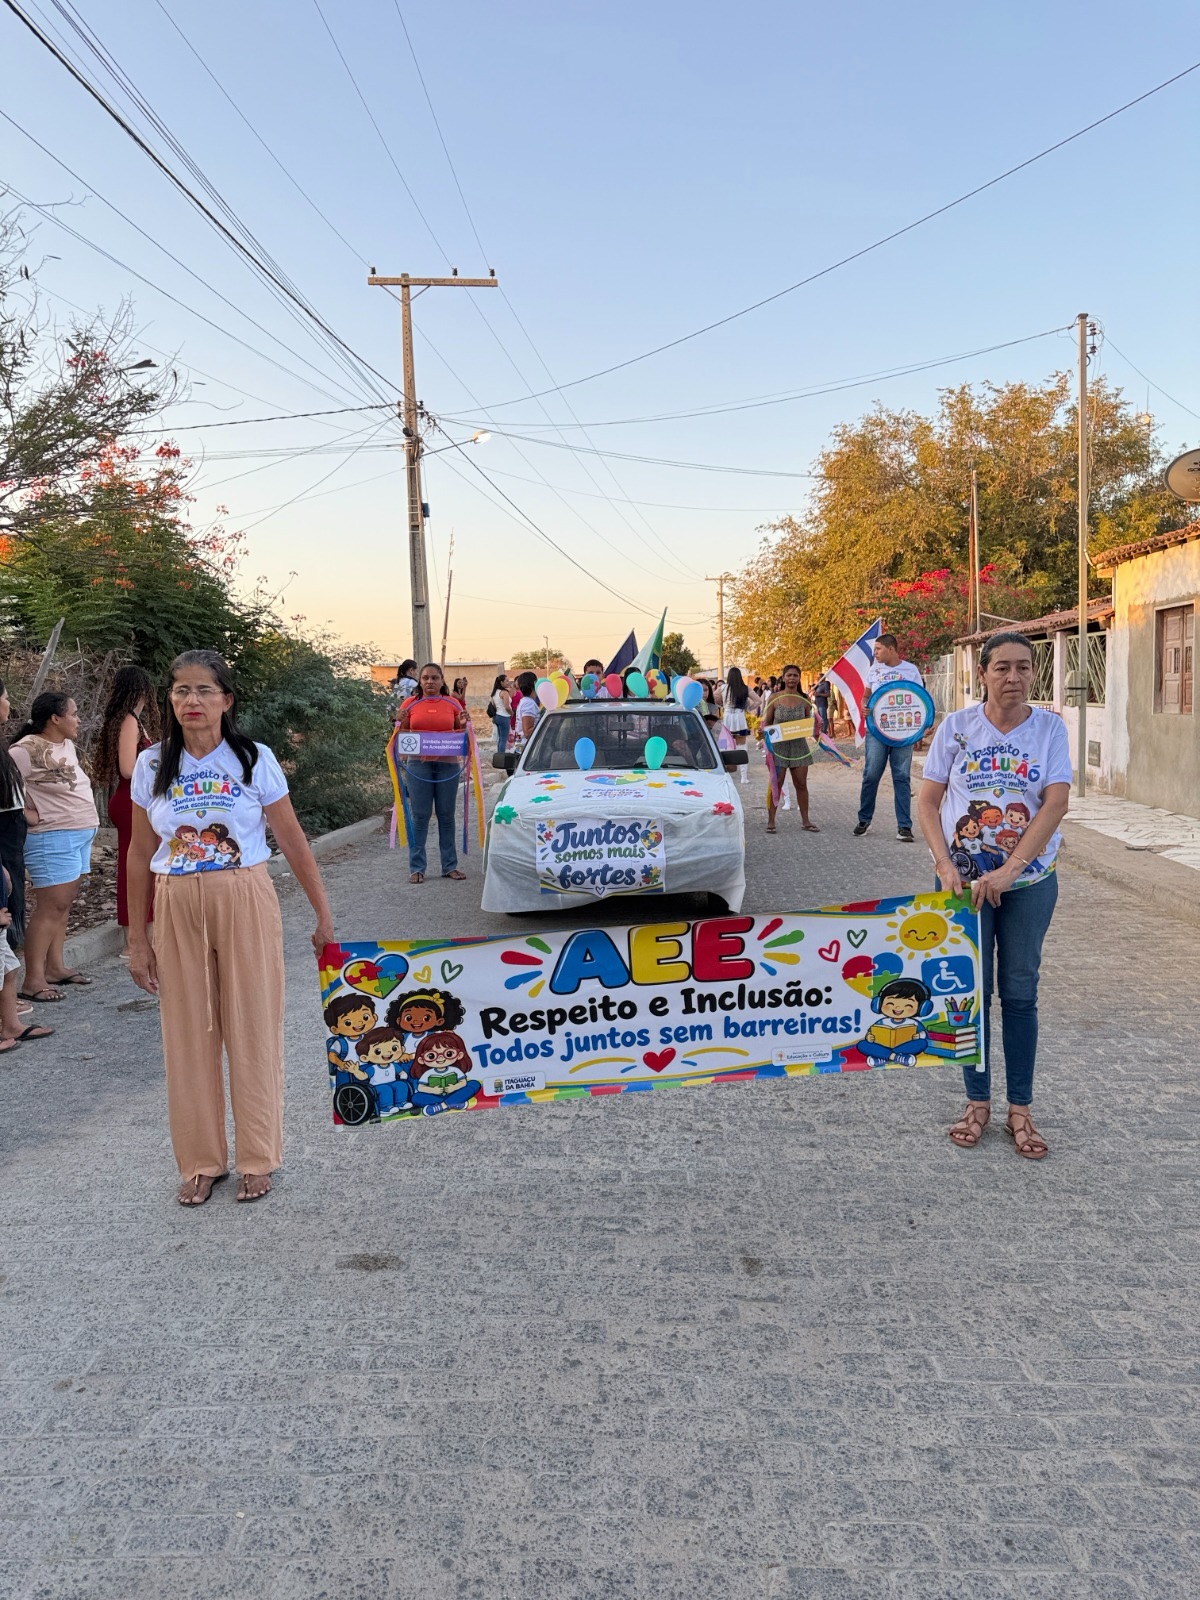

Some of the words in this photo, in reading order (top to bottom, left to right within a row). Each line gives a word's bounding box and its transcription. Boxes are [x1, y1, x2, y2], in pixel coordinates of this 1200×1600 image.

[971, 742, 1020, 761] Respeito
[1022, 752, 1029, 761] e
[176, 769, 219, 787] Respeito
[222, 773, 229, 781] e
[960, 757, 1041, 783] INCLUSÃO
[965, 773, 993, 783] Juntos
[167, 781, 242, 800] INCLUSÃO
[967, 781, 985, 789] uma
[987, 778, 1006, 786] escola
[172, 796, 196, 807] Juntos
[190, 800, 209, 808] escola
[551, 820, 642, 853] Juntos
[554, 848, 604, 864] somos
[607, 844, 646, 859] mais
[557, 863, 636, 889] fortes
[549, 916, 756, 995] AEE
[479, 995, 638, 1039] Respeito
[648, 996, 670, 1017] e
[680, 980, 833, 1015] Inclusão:
[471, 1037, 555, 1068] Todos
[560, 1027, 651, 1062] juntos
[659, 1024, 713, 1045] sem
[723, 1008, 861, 1039] barreiras!
[504, 1076, 536, 1085] ITAGUAÇU
[515, 1082, 536, 1090] BAHIA
